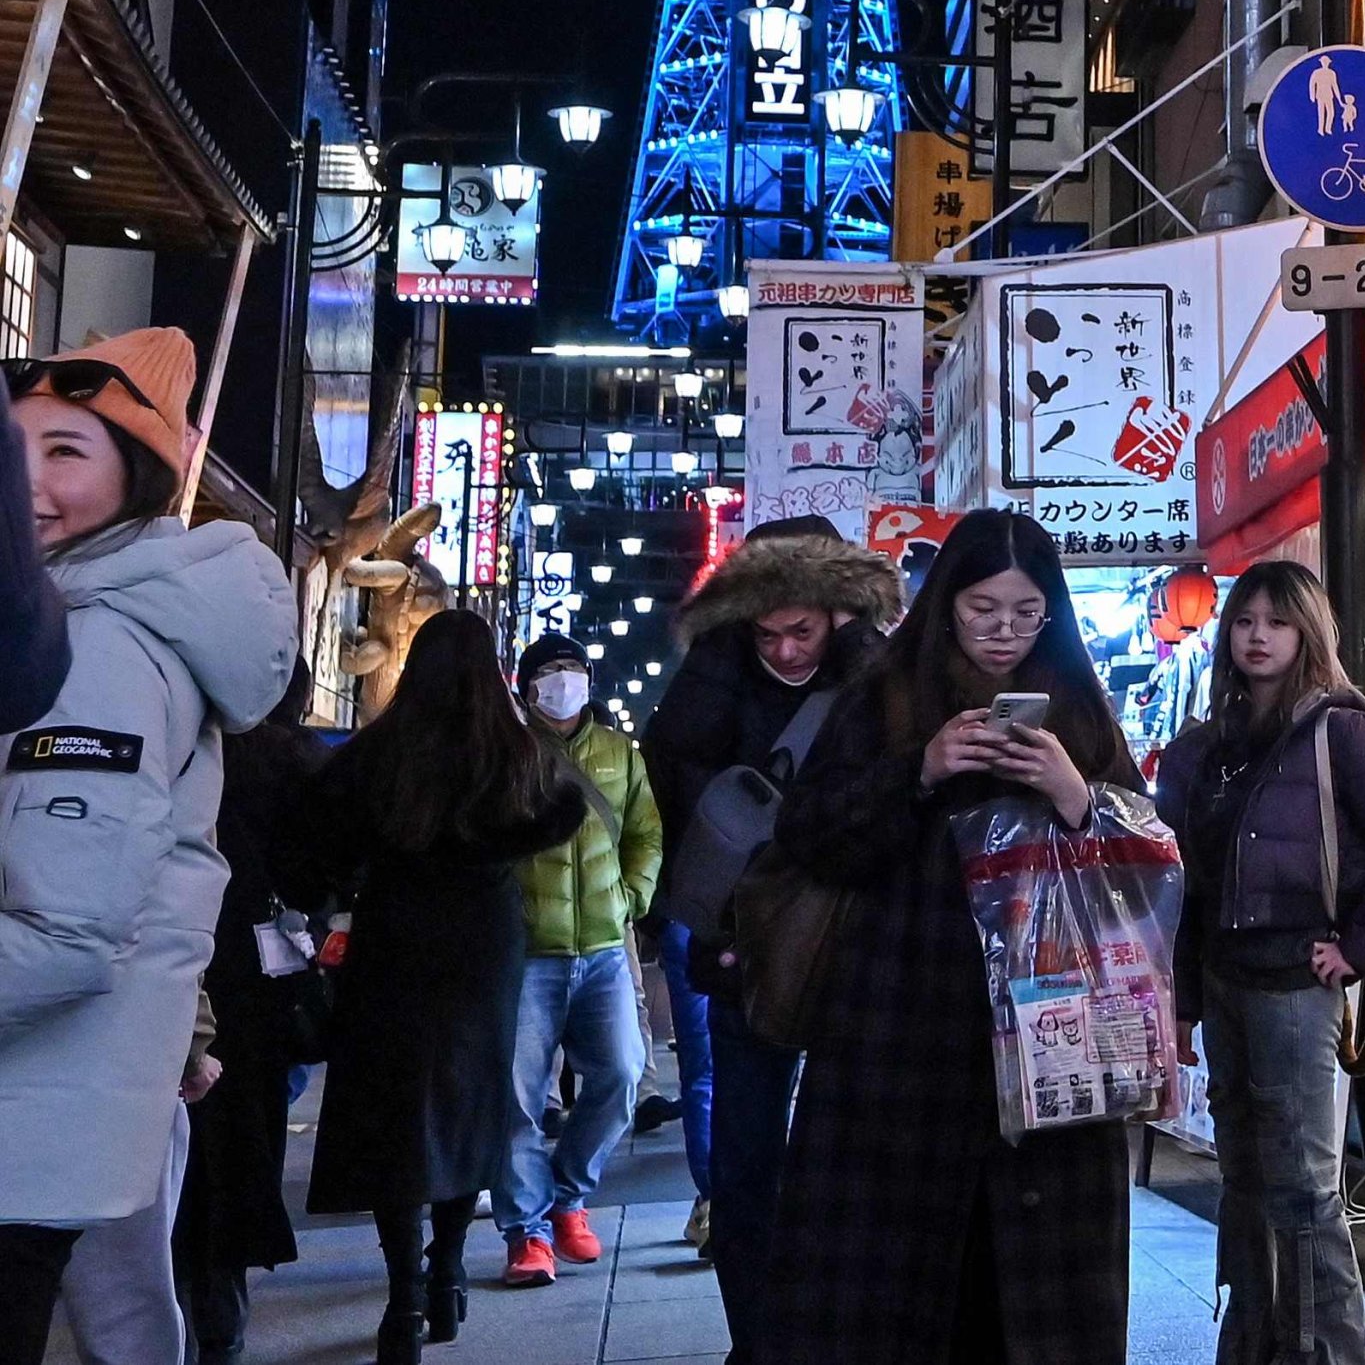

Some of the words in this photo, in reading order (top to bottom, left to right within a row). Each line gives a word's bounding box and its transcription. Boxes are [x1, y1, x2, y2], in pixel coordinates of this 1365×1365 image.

[933, 159, 965, 249] 串揚げ
[758, 282, 915, 305] 元祖串カツ専門店
[1114, 311, 1152, 392] 新世界
[1177, 290, 1196, 405] 商標登録
[1039, 499, 1190, 522] カウンター席
[52, 746, 113, 758] GEOGRAPHIC
[55, 737, 101, 747] NATIONAL
